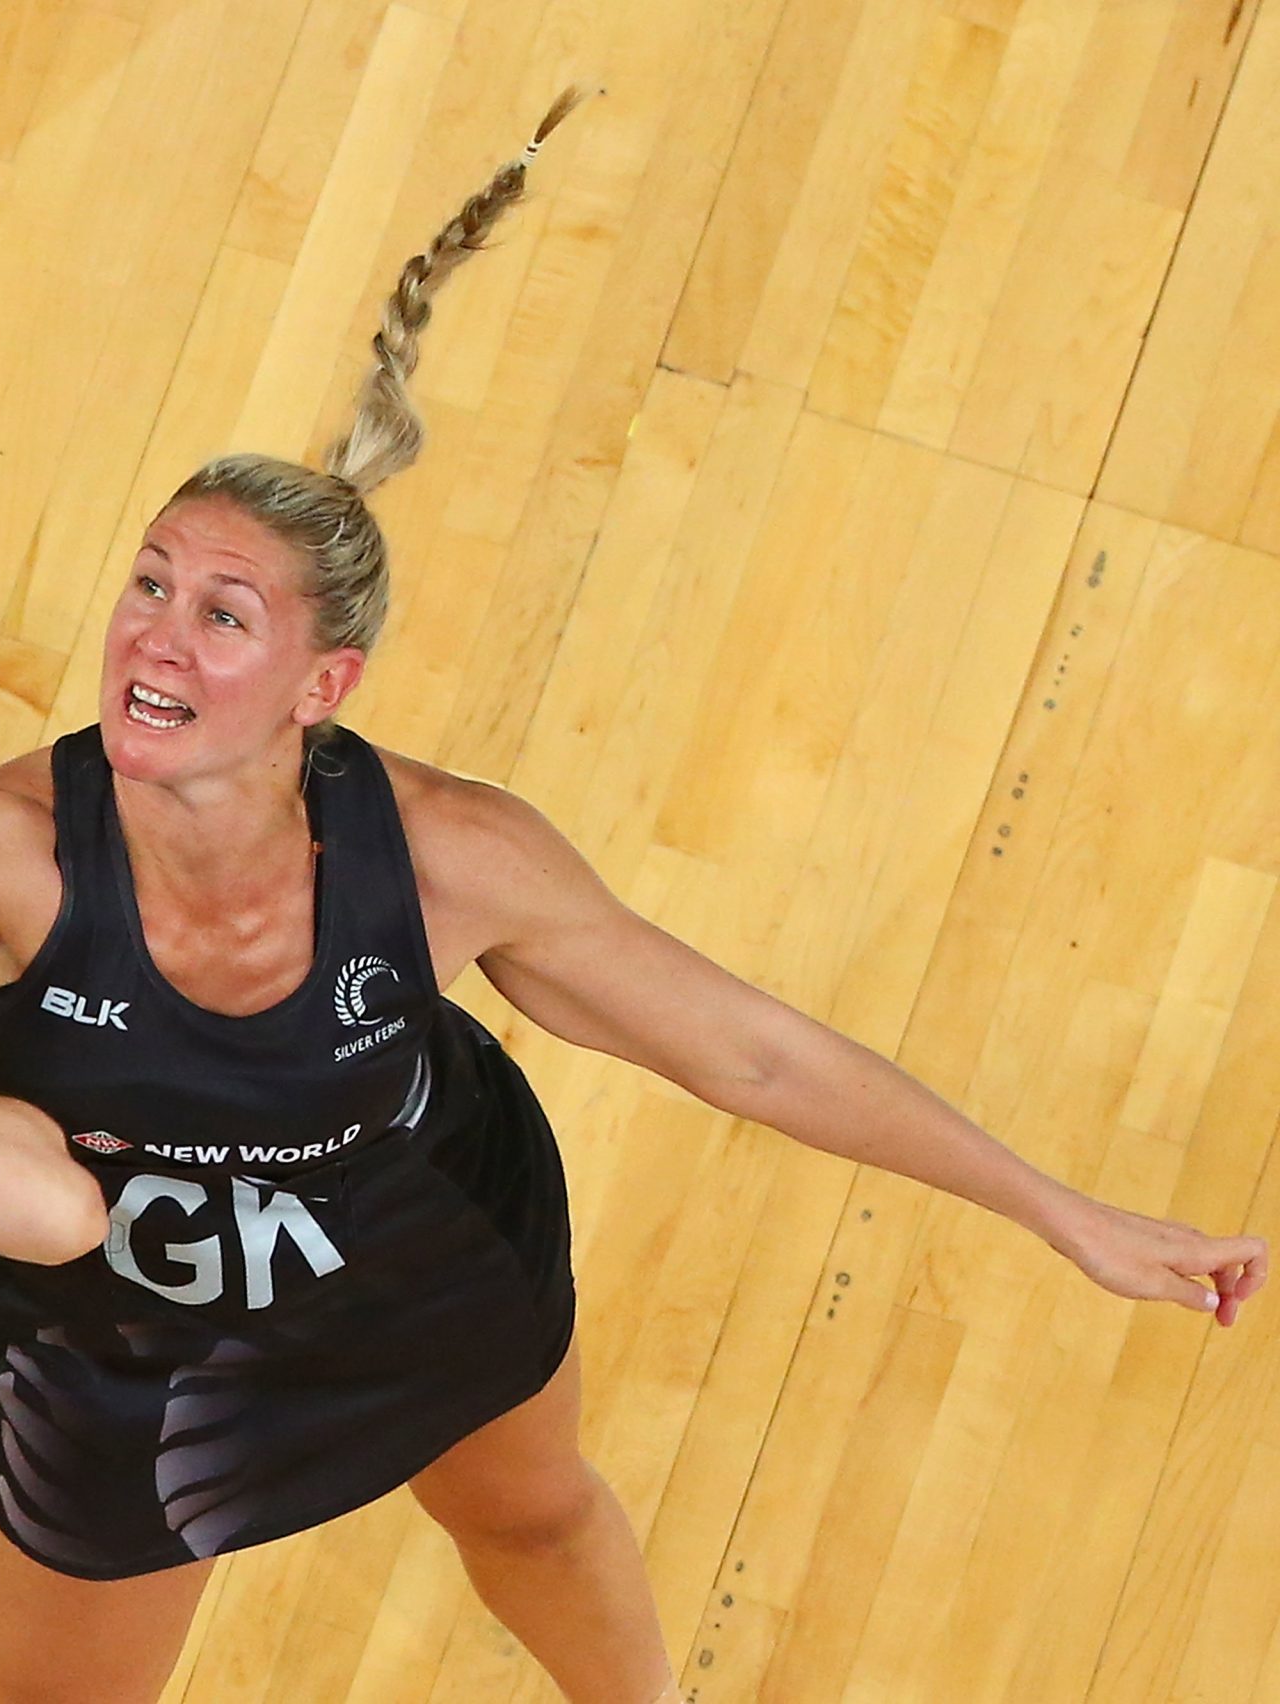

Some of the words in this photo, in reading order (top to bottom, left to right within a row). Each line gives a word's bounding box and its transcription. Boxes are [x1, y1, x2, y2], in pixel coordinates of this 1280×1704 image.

[40, 985, 130, 1031] BLK
[334, 1035, 374, 1062] SILVER
[375, 1016, 406, 1043] FERNS
[145, 1144, 230, 1164] NEW
[238, 1123, 361, 1163] WORLD
[103, 1174, 346, 1310] GK
